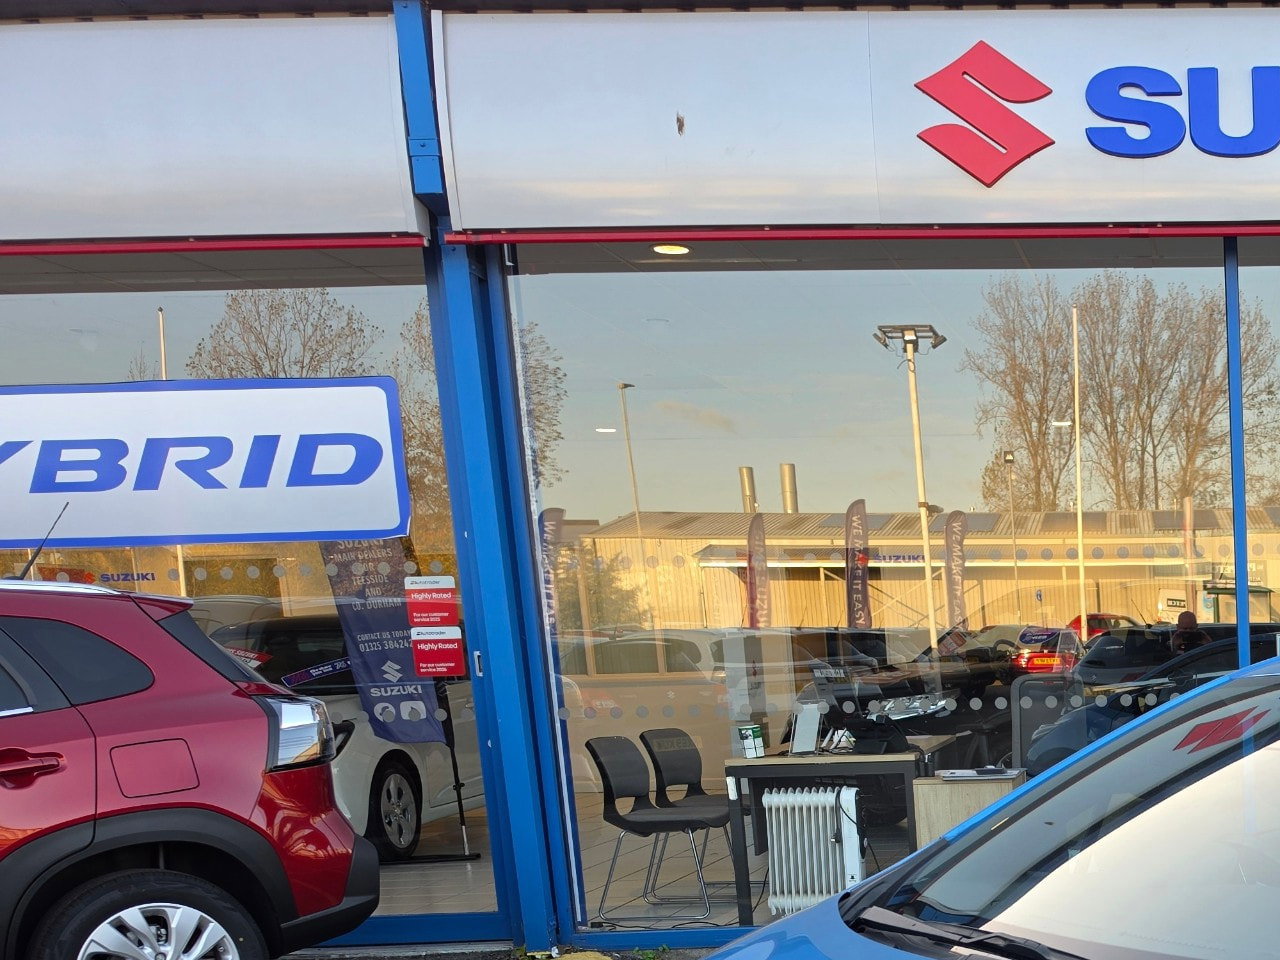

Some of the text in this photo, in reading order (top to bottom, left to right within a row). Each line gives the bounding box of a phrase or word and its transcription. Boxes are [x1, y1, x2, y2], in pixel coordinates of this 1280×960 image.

[357, 548, 393, 561] DEALERS
[100, 572, 156, 583] SUZUKI
[352, 574, 390, 586] TEESSIDE
[365, 587, 382, 598] AND
[411, 591, 452, 601] Highly Rated
[366, 597, 402, 610] DURHAM
[357, 632, 381, 642] CONTACT
[392, 630, 412, 639] TODAY
[360, 642, 382, 652] 01325
[417, 642, 458, 651] Highly Rated
[370, 684, 422, 697] SUZUKI
